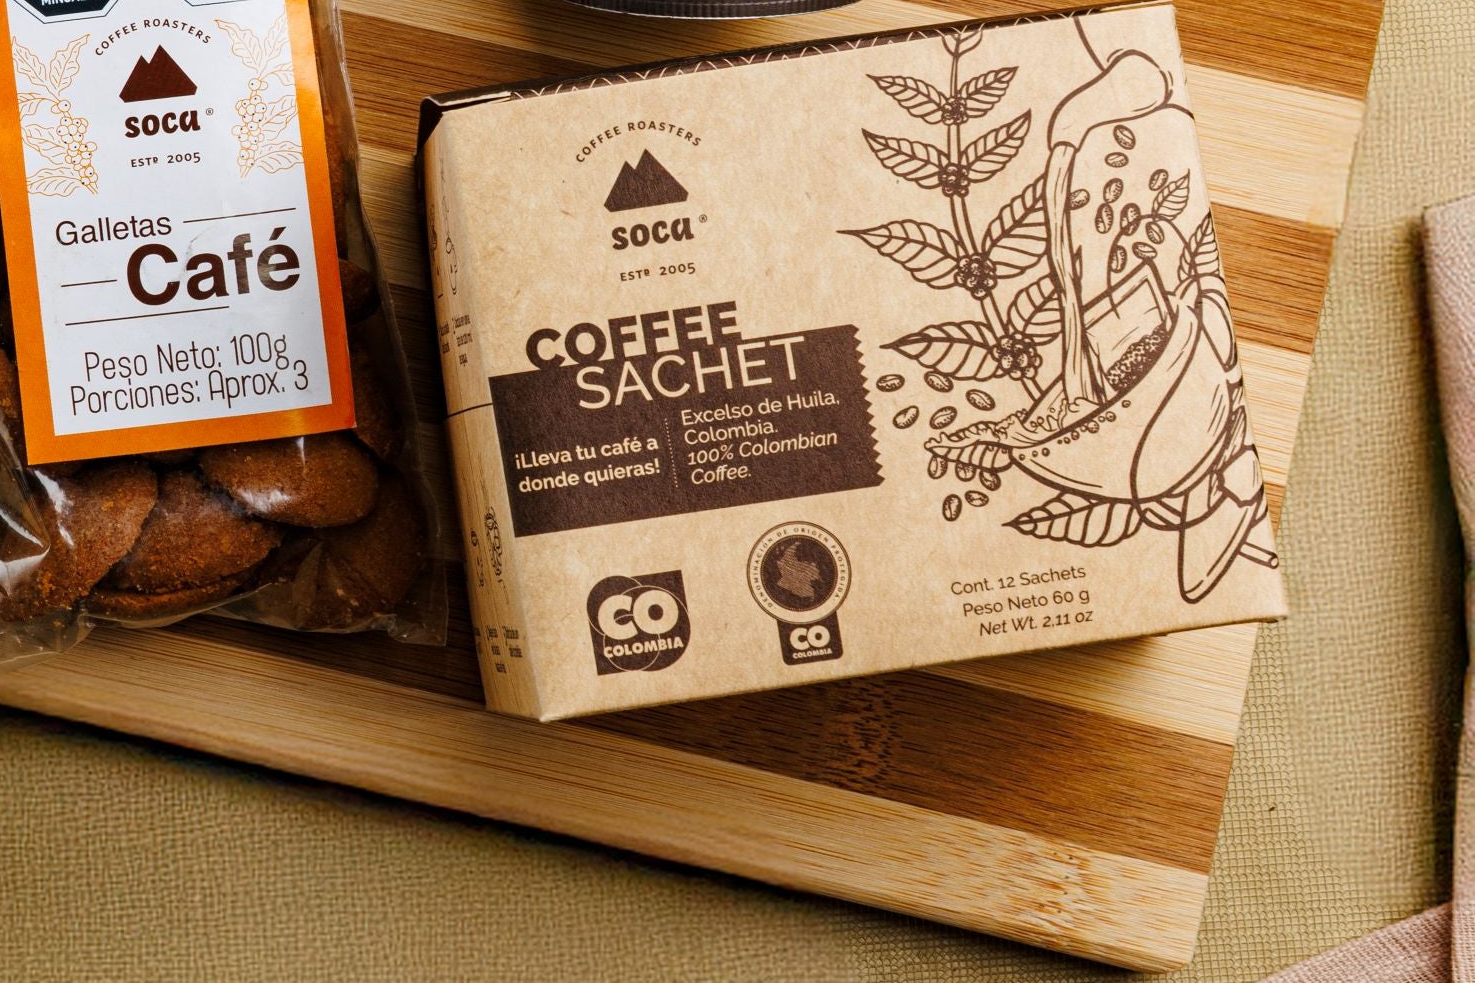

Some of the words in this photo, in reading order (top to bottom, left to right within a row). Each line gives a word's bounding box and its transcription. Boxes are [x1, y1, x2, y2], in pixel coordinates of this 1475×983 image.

[94, 22, 138, 56] COFFEE
[143, 18, 212, 45] ROASTERS
[576, 125, 622, 163] COFFEE
[627, 120, 702, 147] ROASTERS
[167, 152, 202, 165] 2005
[55, 216, 172, 246] Galletas
[126, 226, 301, 306] Café
[659, 262, 696, 277] 2005
[525, 300, 742, 370] COFFEE
[84, 351, 148, 382] Peso
[156, 341, 222, 374] Neto:
[230, 332, 290, 371] 100g
[576, 335, 805, 410] SACHET
[70, 378, 201, 416] Porciones:
[208, 369, 286, 409] Aprox.
[293, 359, 309, 390] 3
[681, 402, 753, 427] Excelso
[757, 395, 782, 415] de
[786, 389, 840, 412] Huila,
[684, 419, 778, 447] Colombia.
[687, 446, 734, 466] 100%
[738, 430, 838, 459] Colombian
[514, 450, 572, 470] ¡Lleva
[575, 444, 597, 461] tu
[600, 436, 642, 457] café
[645, 438, 659, 452] a
[518, 466, 580, 494] donde
[584, 458, 661, 488] quieras!
[690, 464, 752, 486] Coffee.
[777, 529, 788, 538] DE
[793, 527, 829, 544] ORIGEN
[950, 577, 994, 595] Cont.
[998, 576, 1016, 590] 12
[1019, 566, 1086, 587] Sachets
[598, 589, 679, 640] CO
[962, 601, 1004, 617] Peso
[1007, 595, 1048, 611] Neto
[1052, 590, 1074, 605] 60
[1079, 589, 1090, 604] g
[789, 624, 831, 651] CO
[979, 620, 1008, 637] Net
[1011, 616, 1038, 632] Wt.
[1075, 610, 1094, 624] oz
[603, 636, 685, 659] COLOMBIA
[792, 648, 833, 660] COLOMBIA
